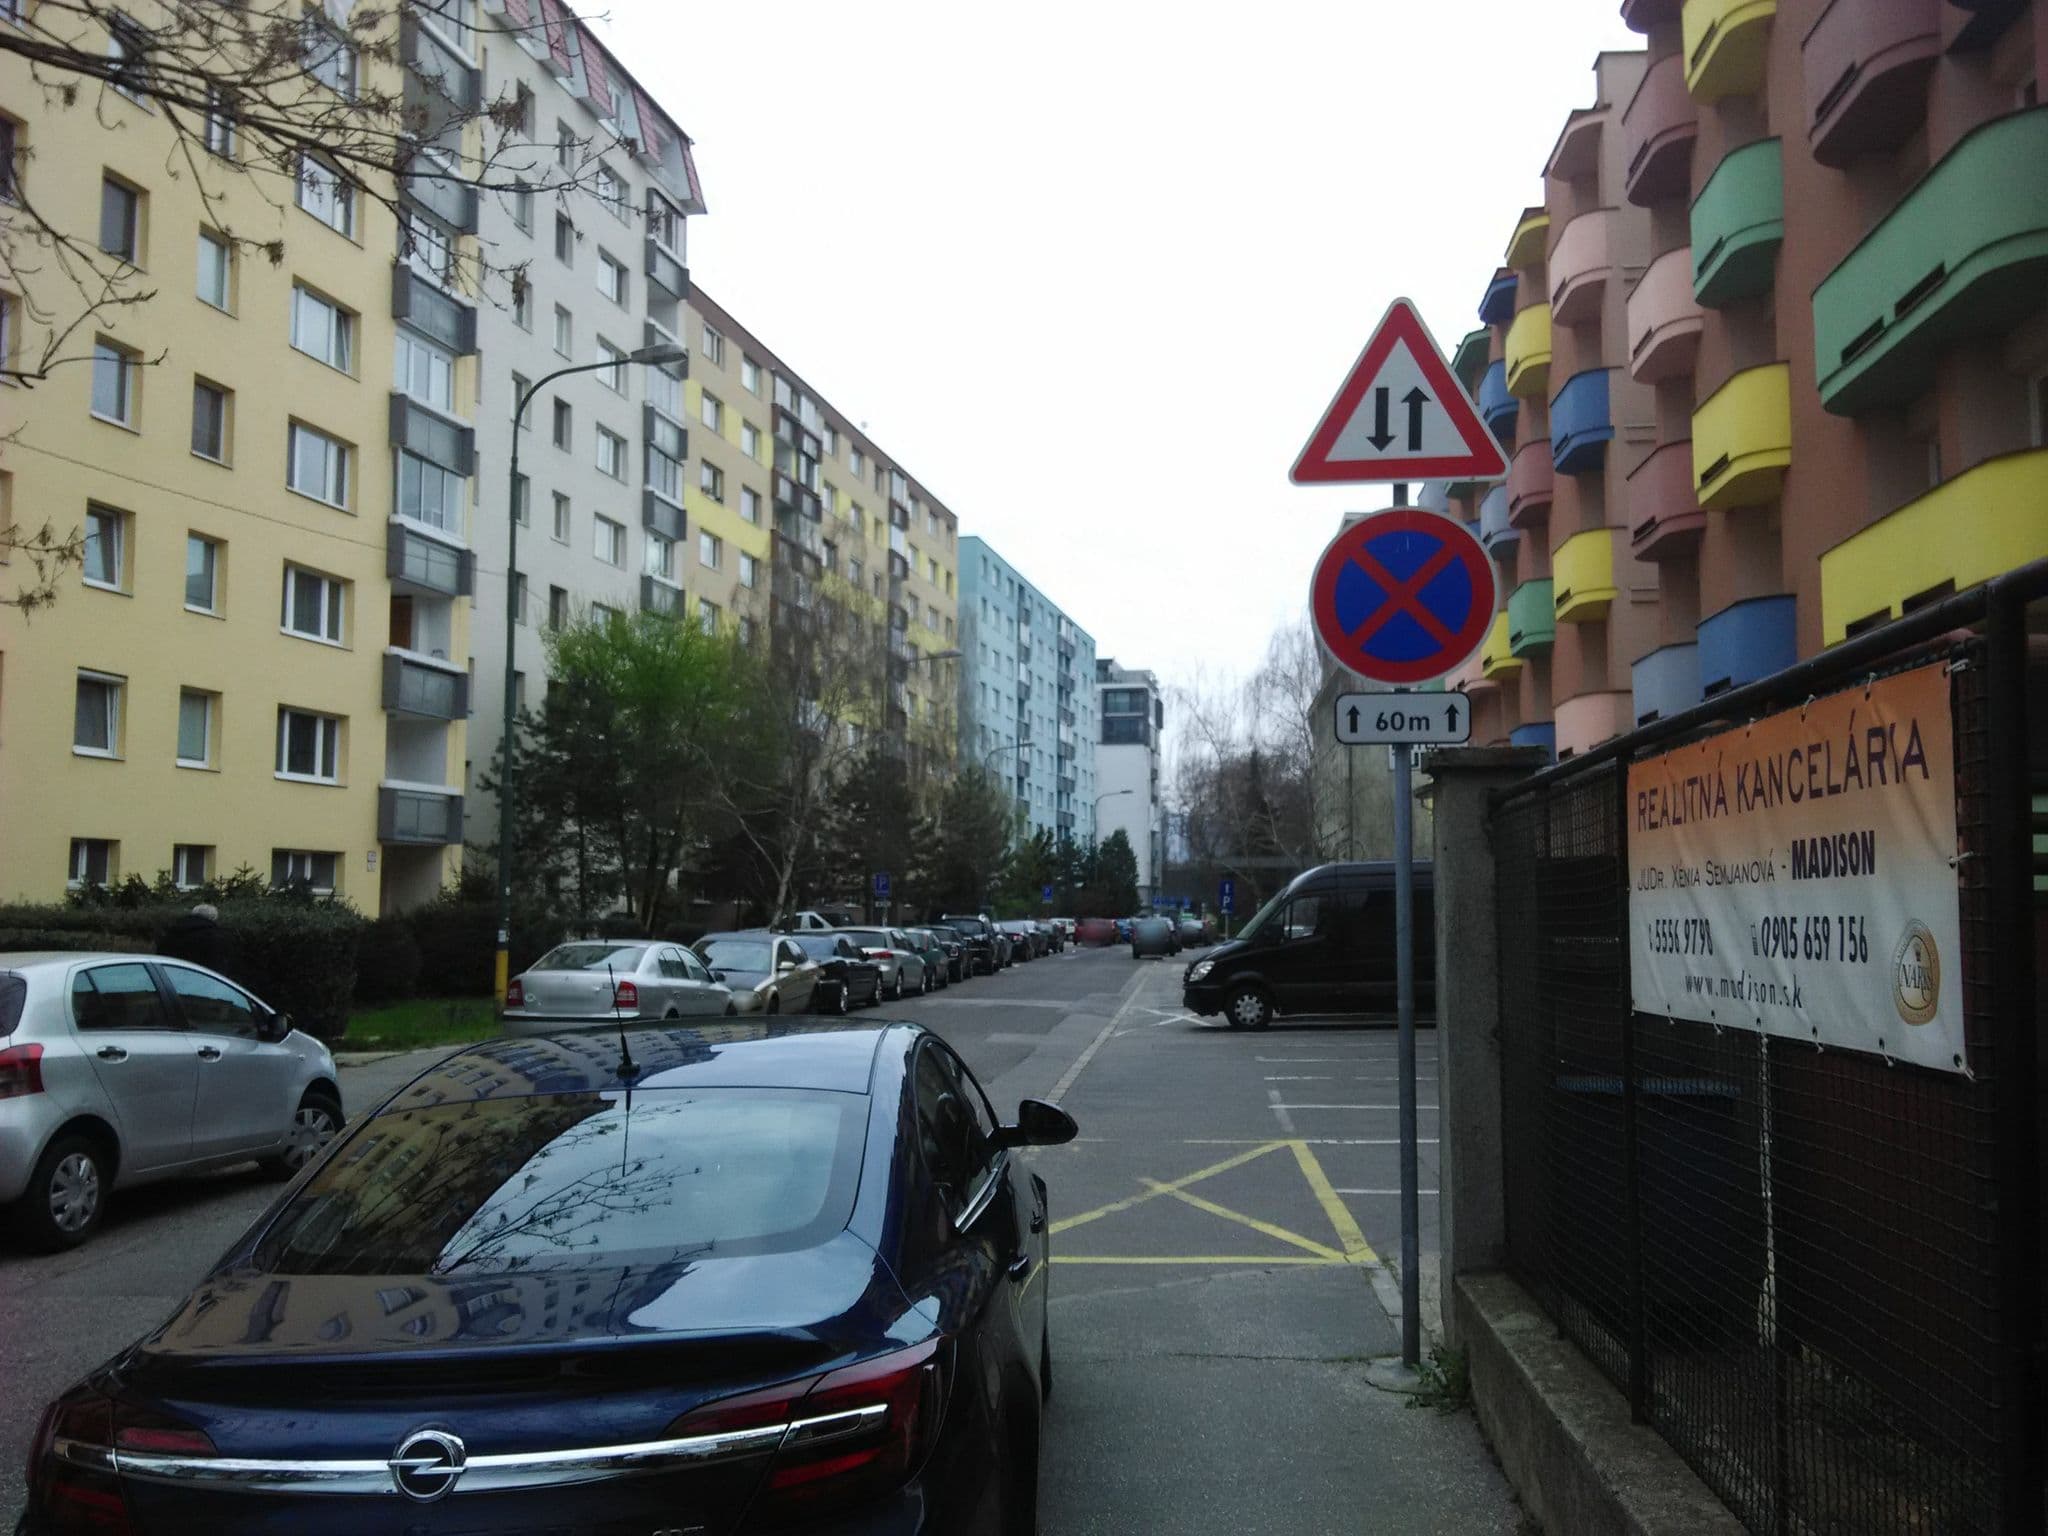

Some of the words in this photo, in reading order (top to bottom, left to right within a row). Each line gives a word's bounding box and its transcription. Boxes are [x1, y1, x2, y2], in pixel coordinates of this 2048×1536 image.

[1375, 711, 1430, 731] 60m
[1638, 752, 1728, 832] REALITNÁ
[1737, 708, 1929, 814] KANCELÁRIA
[1792, 830, 1875, 880] MADISON
[1655, 918, 1681, 954] 5556
[1684, 917, 1714, 956] 9798
[1761, 915, 1798, 960] 0905
[1804, 915, 1831, 961] 659
[1838, 915, 1869, 964] 156
[1684, 969, 1802, 1009] www.madison.sk
